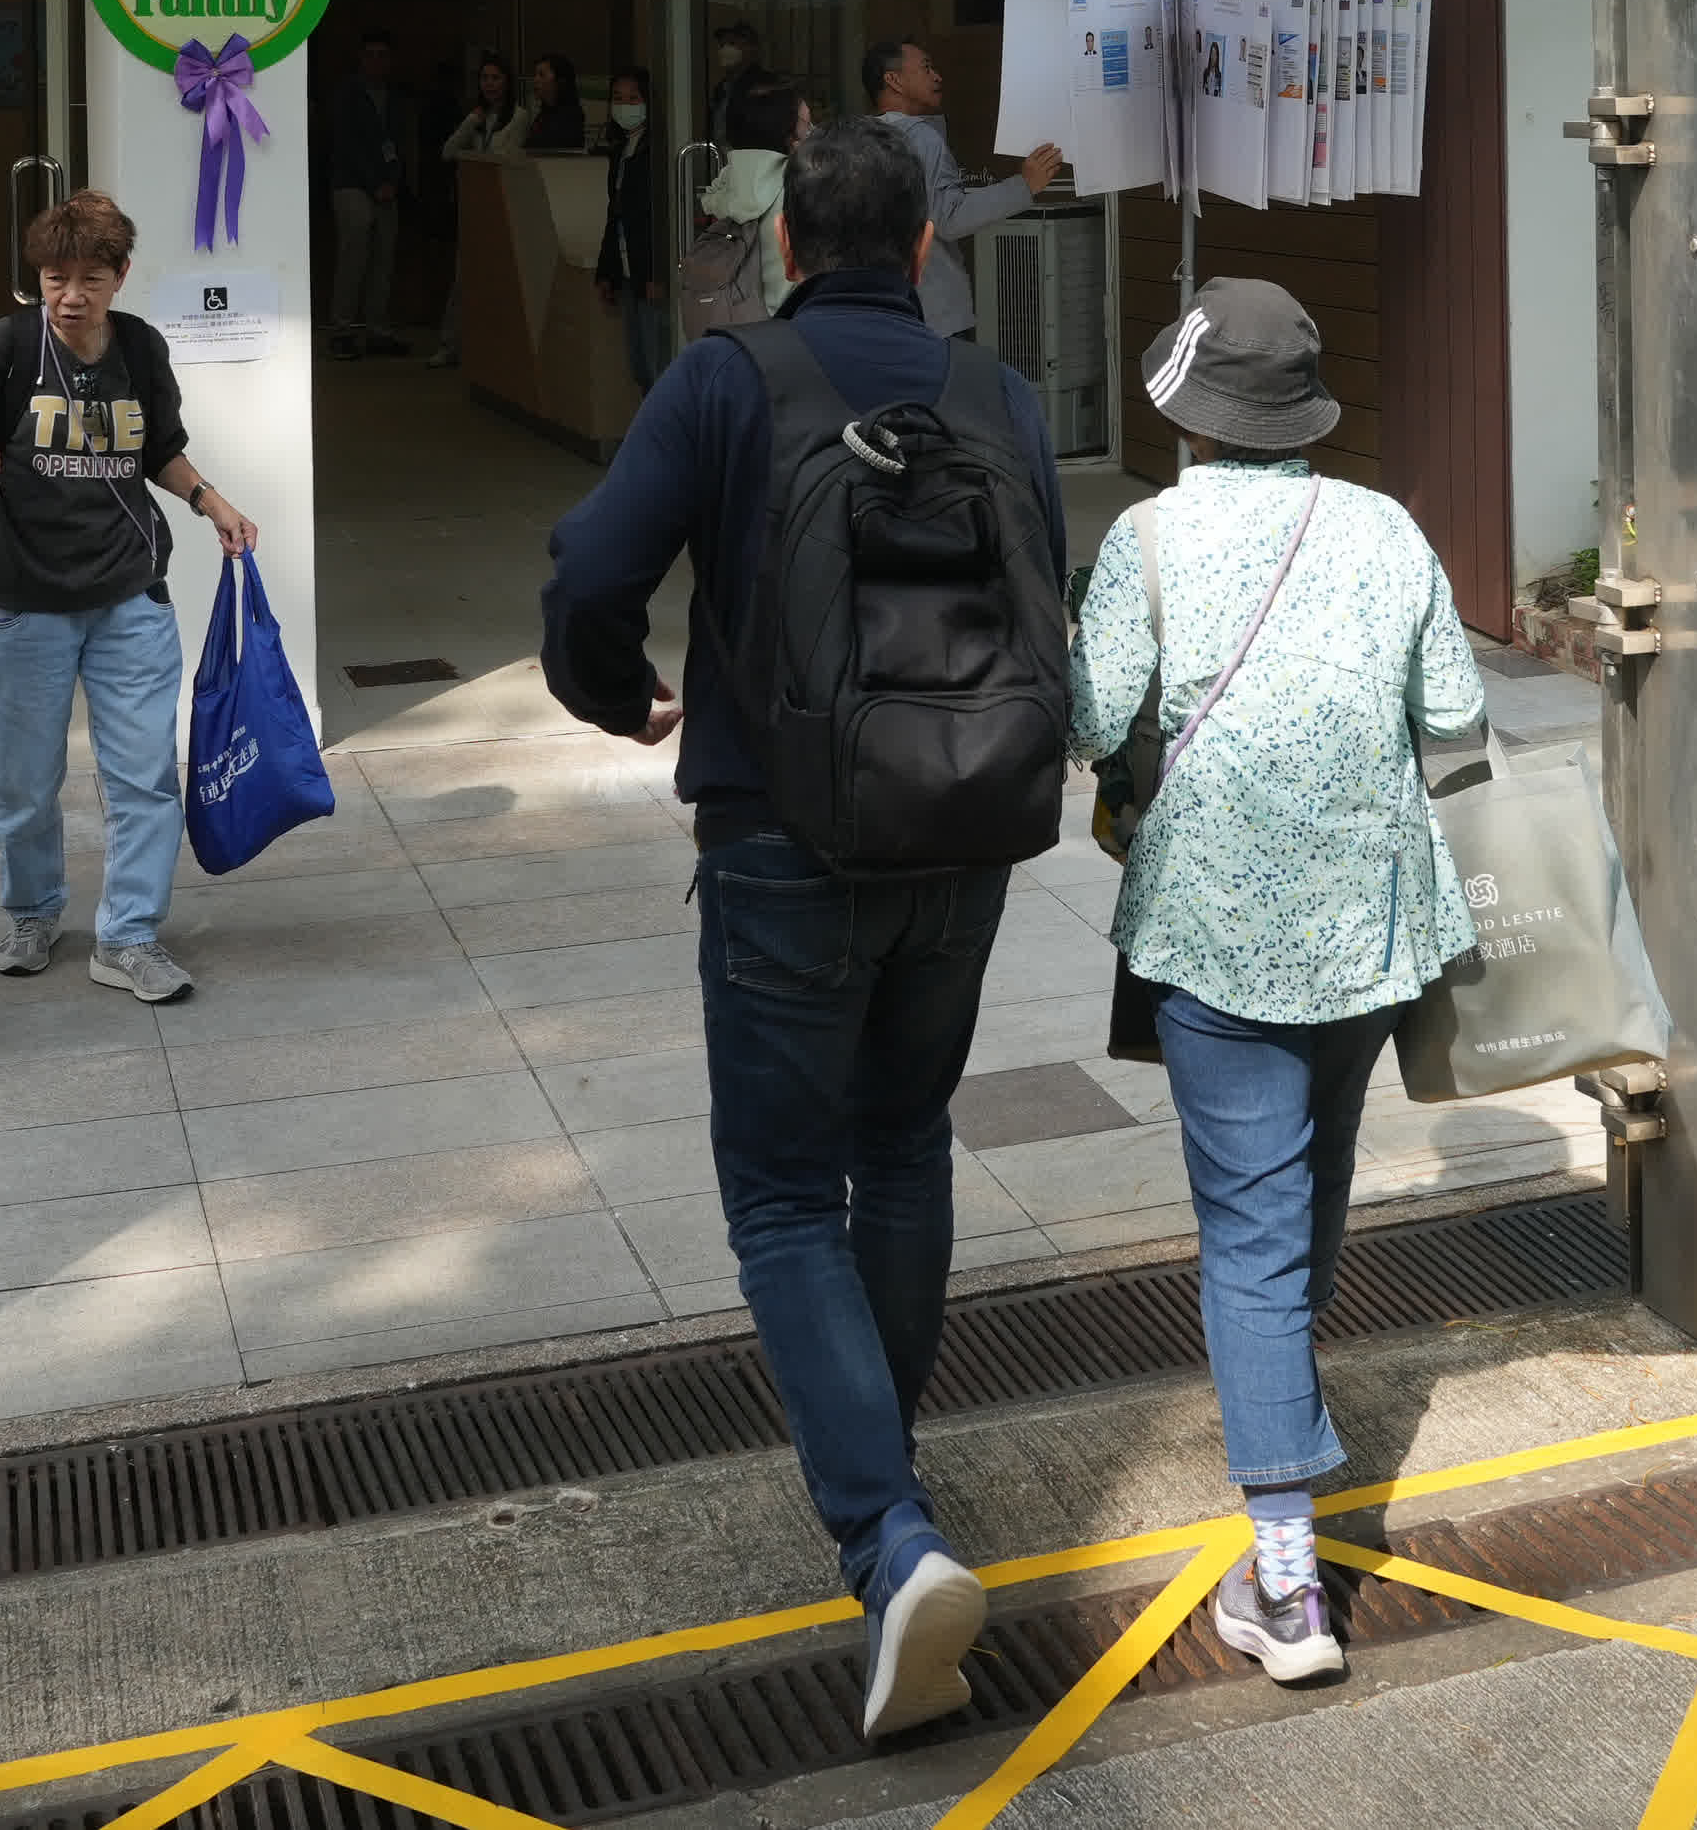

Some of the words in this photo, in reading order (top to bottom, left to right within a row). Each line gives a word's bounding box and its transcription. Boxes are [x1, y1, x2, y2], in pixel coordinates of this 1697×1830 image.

[29, 394, 146, 453] THE
[30, 453, 137, 479] OPENING
[1501, 905, 1566, 929] LESTIE
